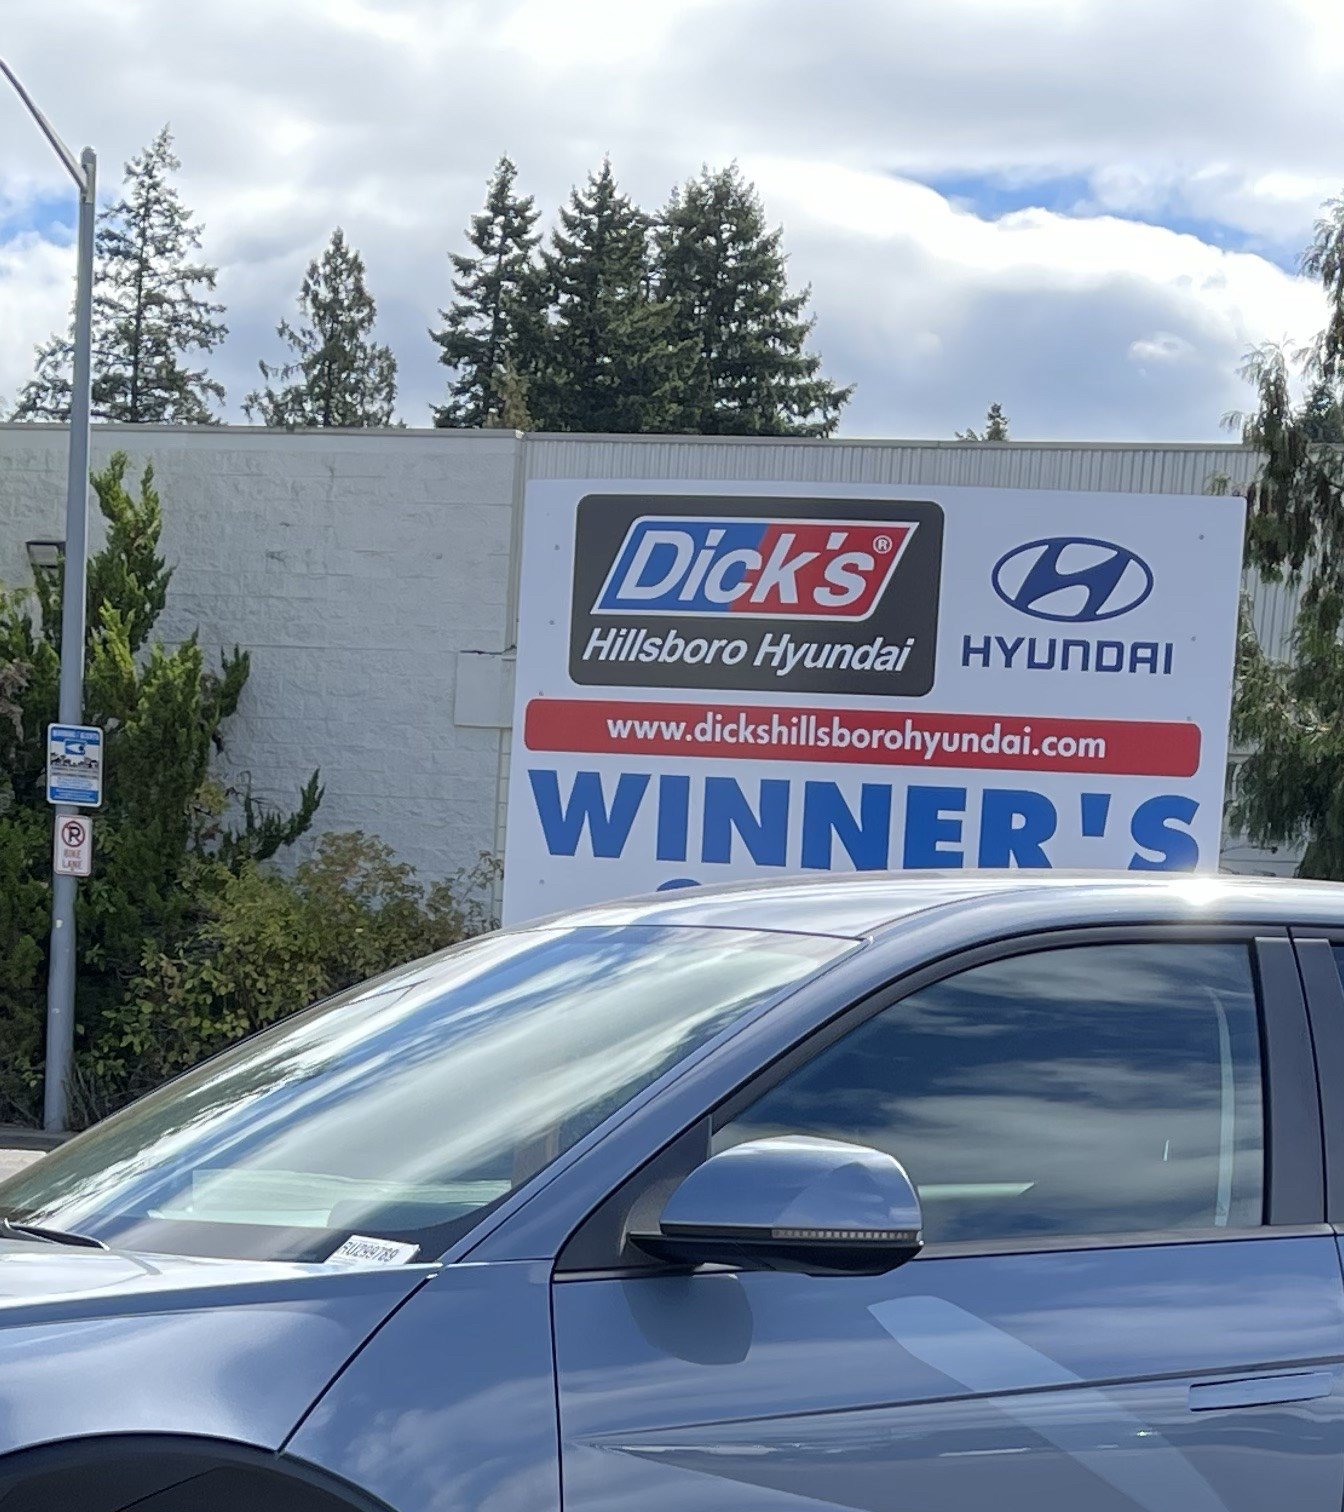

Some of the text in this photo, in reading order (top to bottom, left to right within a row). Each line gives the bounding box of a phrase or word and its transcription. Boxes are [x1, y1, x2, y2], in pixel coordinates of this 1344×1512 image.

[582, 627, 915, 677] Hillsboro Hyundai
[961, 634, 1174, 675] HYUNDAI
[606, 711, 1107, 760] www.dickshillsborohyundai.com
[527, 769, 1201, 871] WINNER'S
